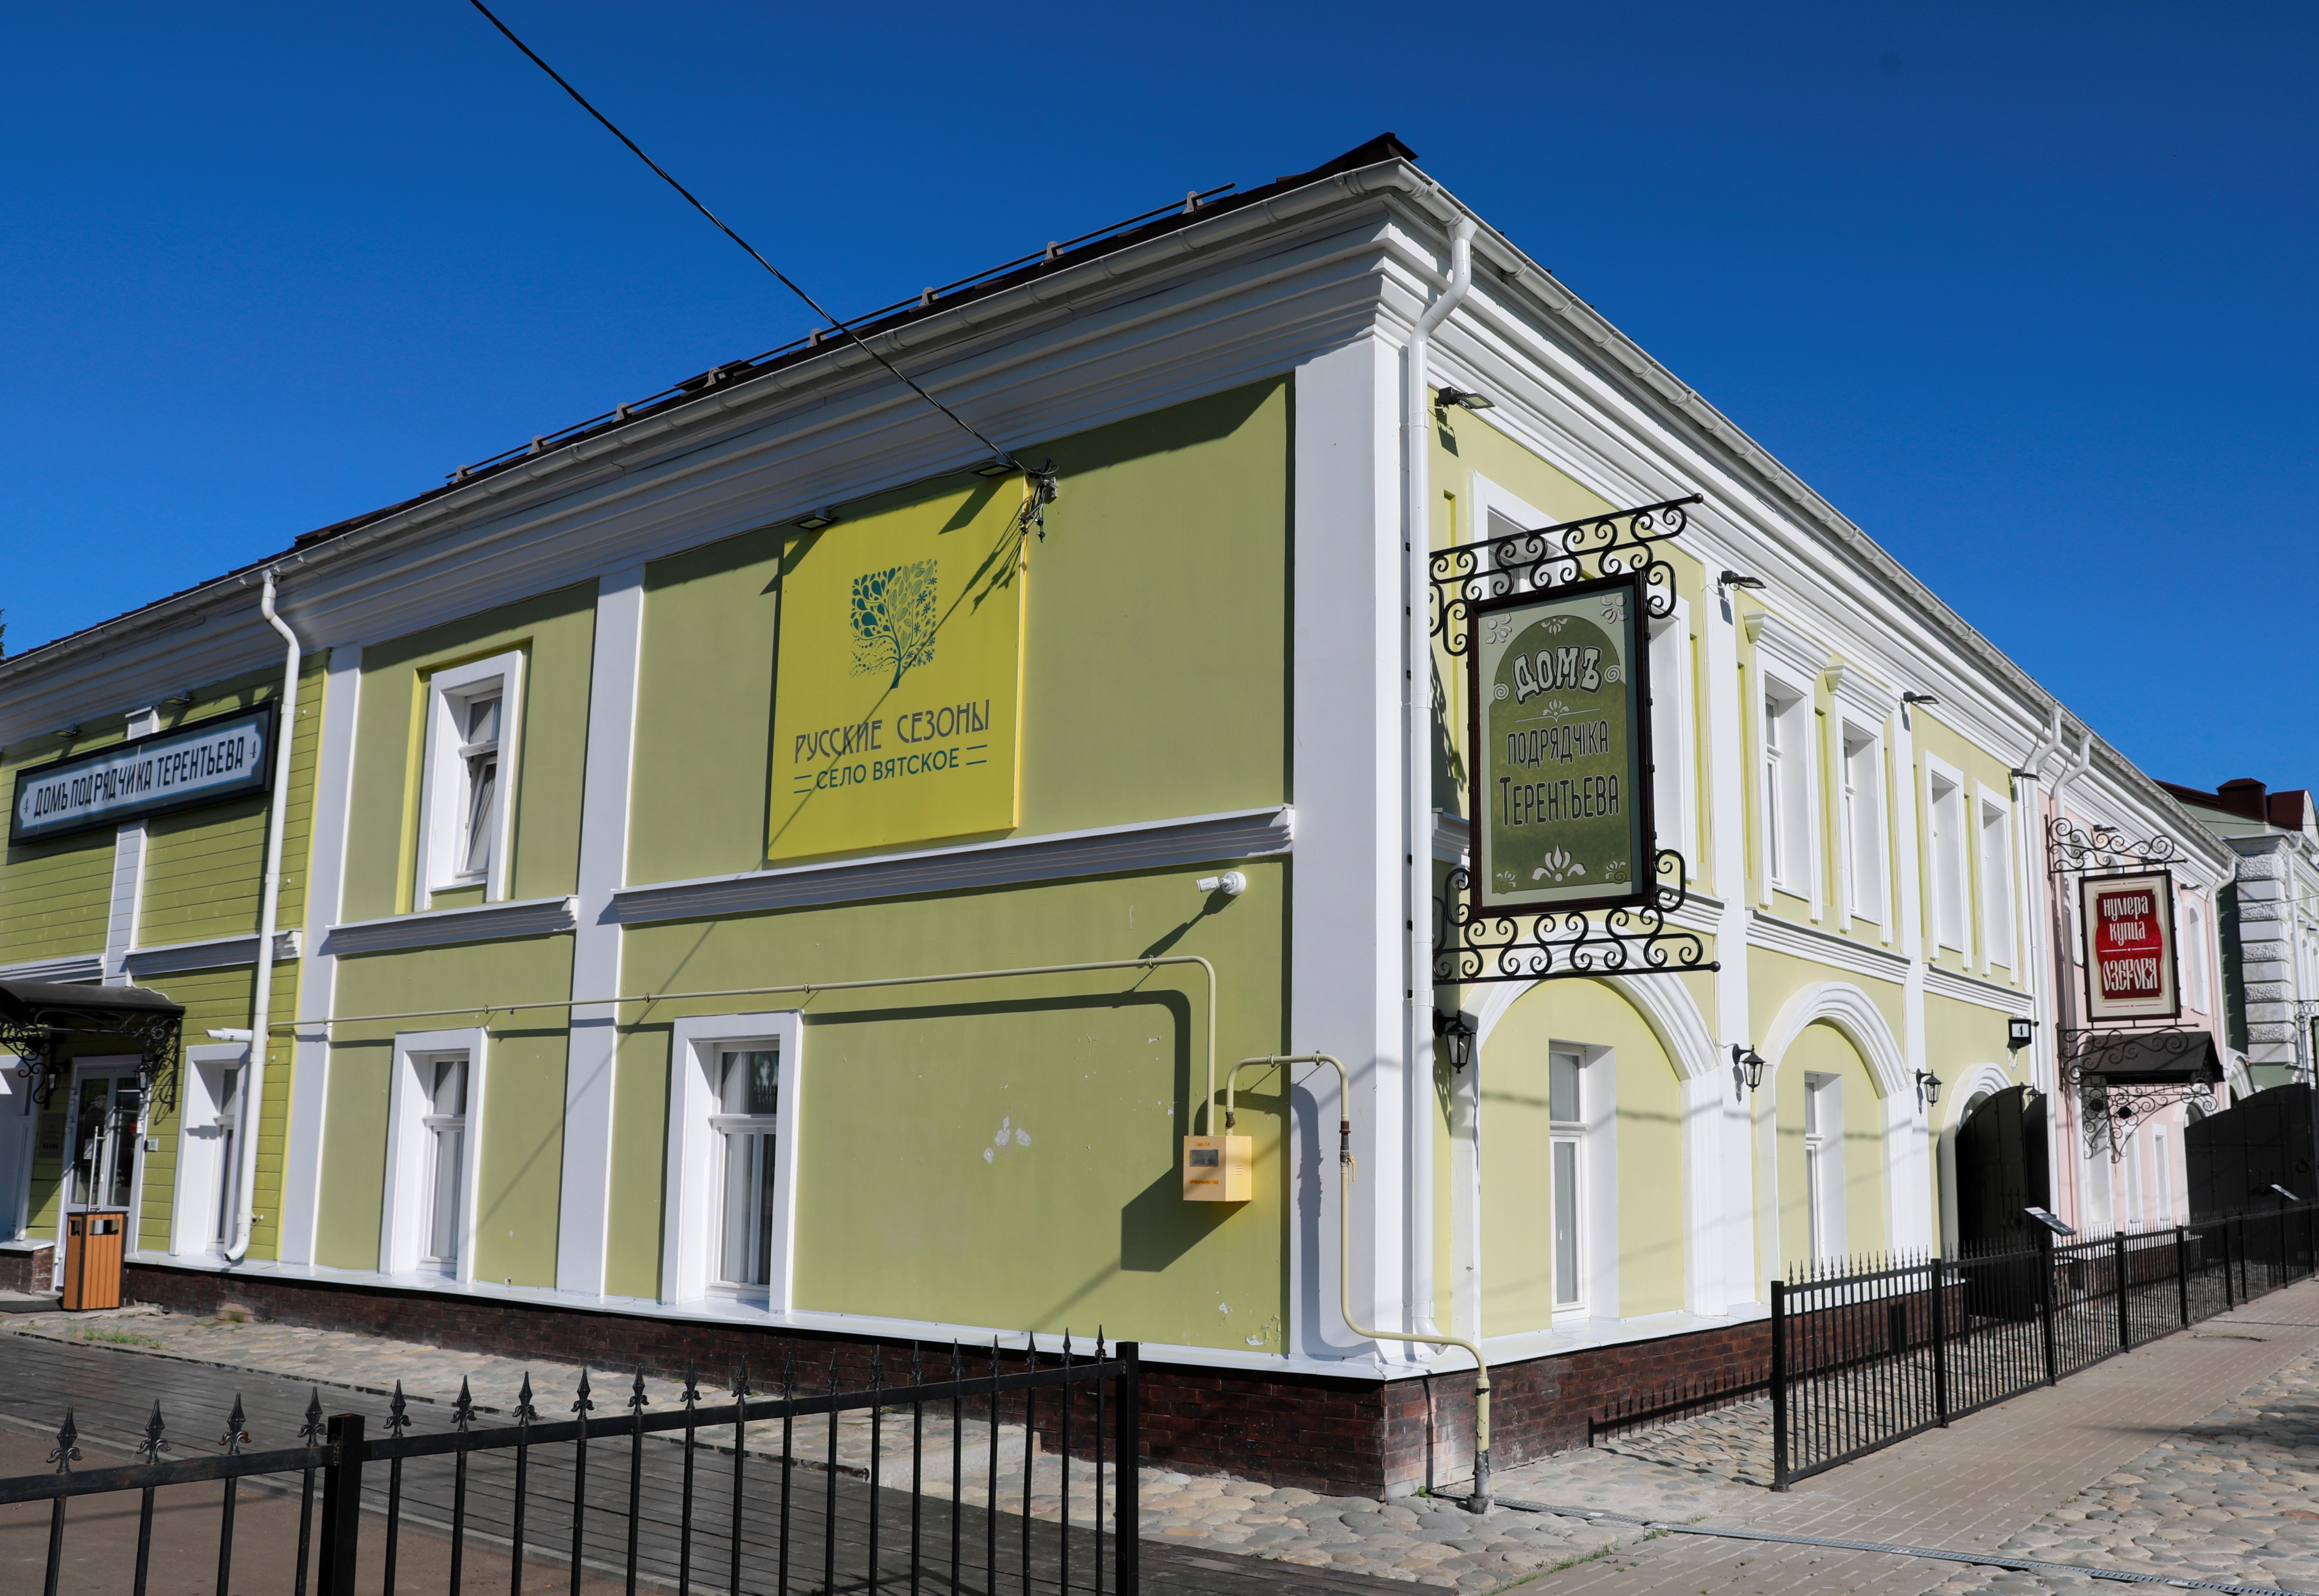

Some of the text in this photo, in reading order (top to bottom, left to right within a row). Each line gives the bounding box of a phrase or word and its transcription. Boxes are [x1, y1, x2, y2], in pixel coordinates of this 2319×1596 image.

[1513, 647, 1602, 705] ДОМЪ
[795, 699, 990, 764] РУССКИЕ СЕЗОНЫ
[23, 737, 256, 818] 4 ДОМЪ ПОДРЯДЧИКА ТЕРЕНТЬЕВА 4
[817, 748, 959, 789] СЕЛО ВЯТСКОЕ
[2017, 1025, 2024, 1035] 4
